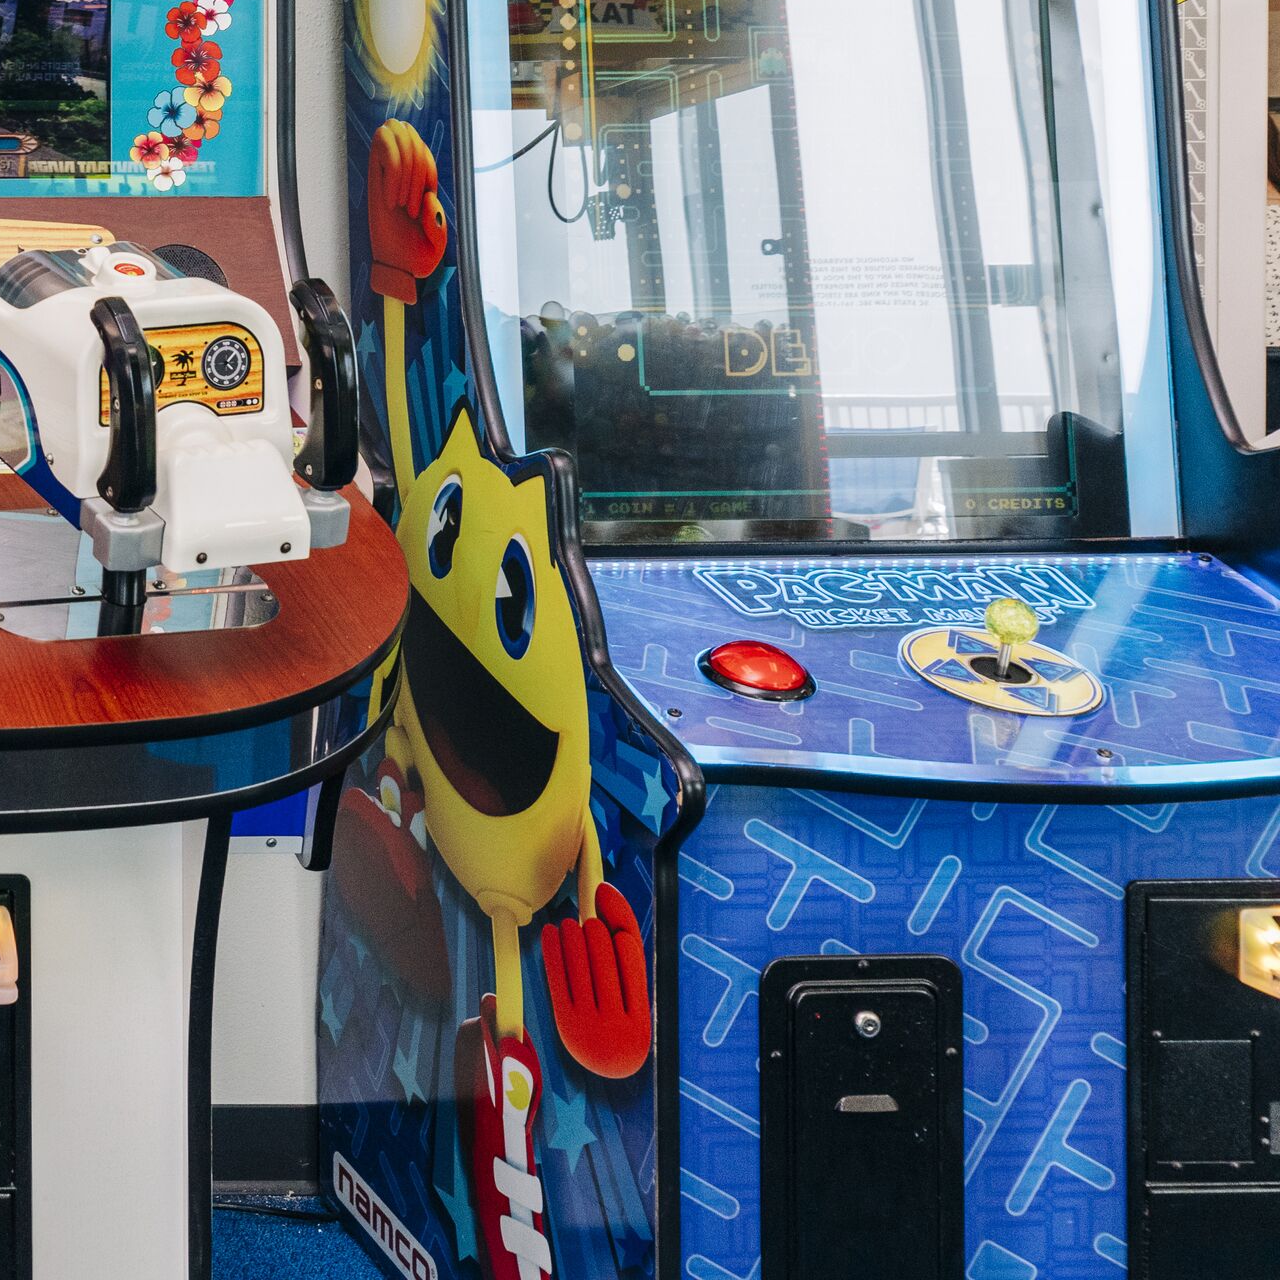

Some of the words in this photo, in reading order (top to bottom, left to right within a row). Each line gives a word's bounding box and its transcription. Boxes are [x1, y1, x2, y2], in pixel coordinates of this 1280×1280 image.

[987, 497, 1066, 510] CREDITS
[792, 607, 908, 625] TICKET
[339, 1162, 430, 1280] namco
